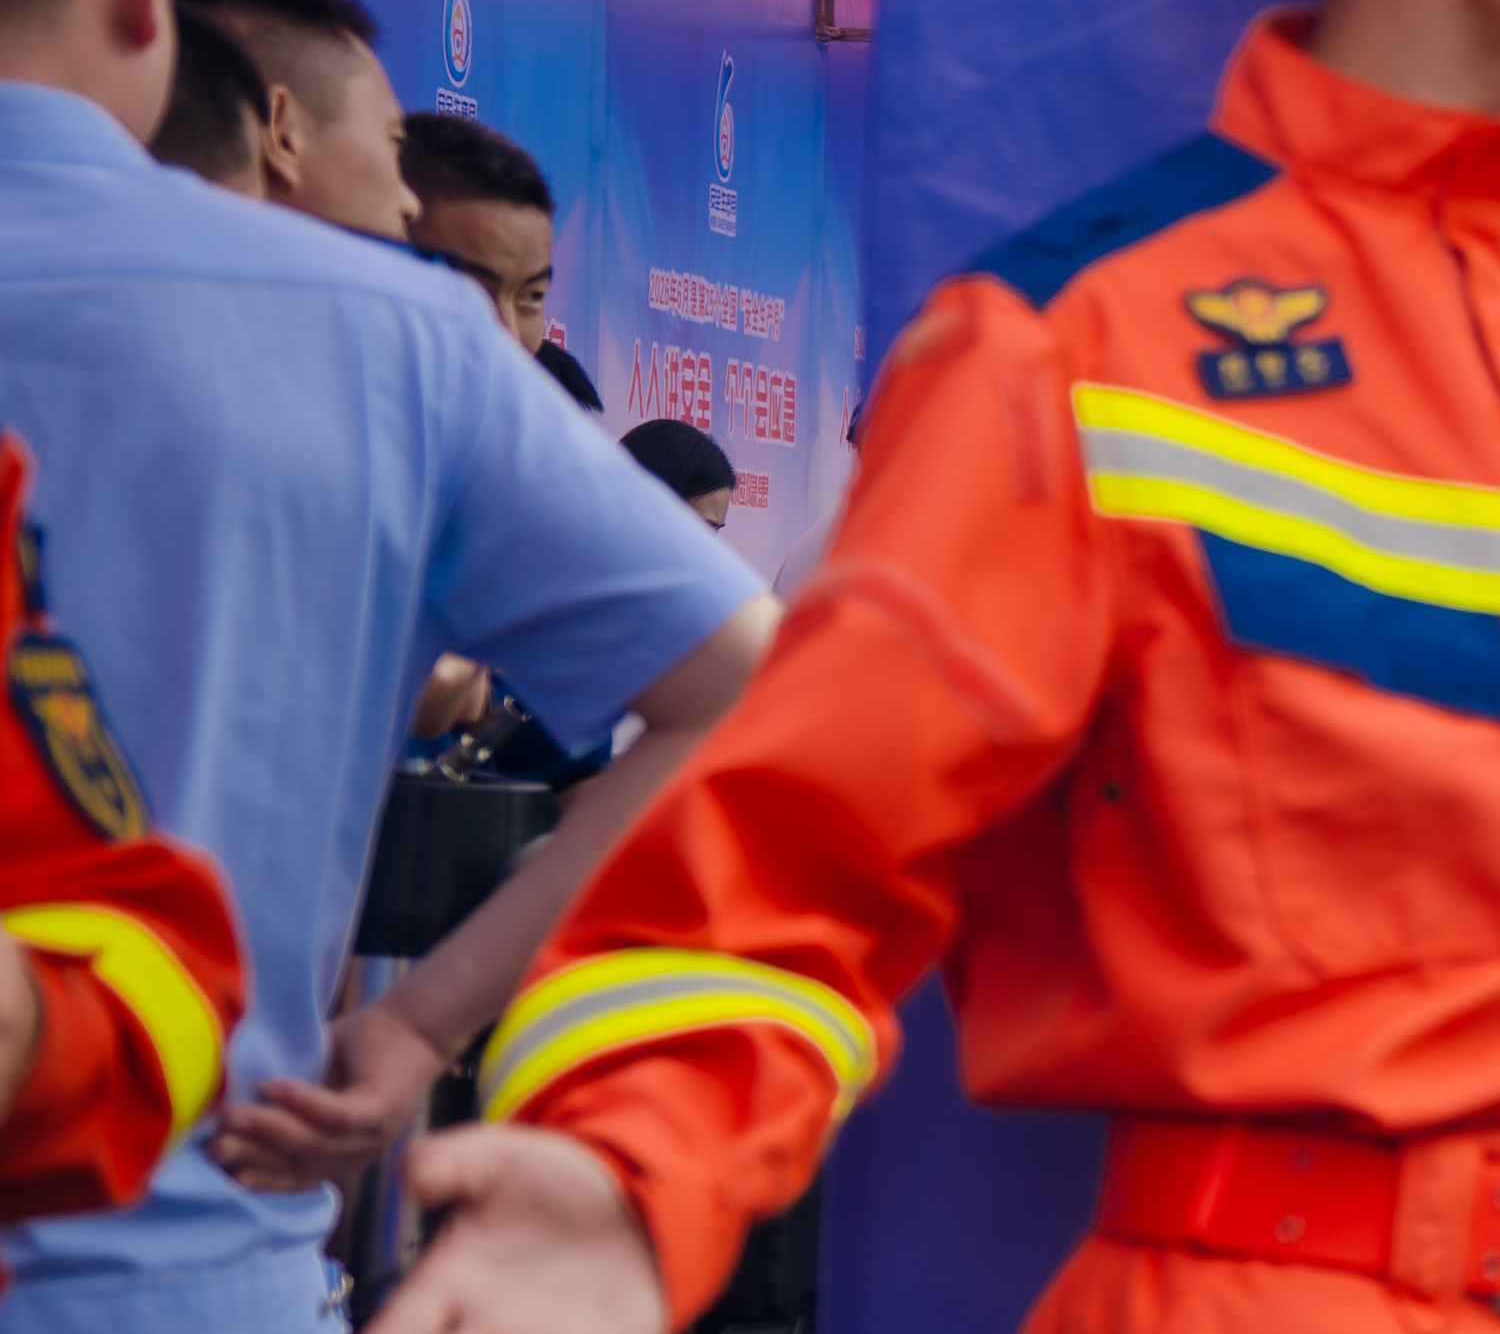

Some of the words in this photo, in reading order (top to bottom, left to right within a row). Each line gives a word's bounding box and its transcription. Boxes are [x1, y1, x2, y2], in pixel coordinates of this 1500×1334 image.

[628, 343, 712, 429] 人人讲安全
[725, 363, 796, 444] 个个会应急
